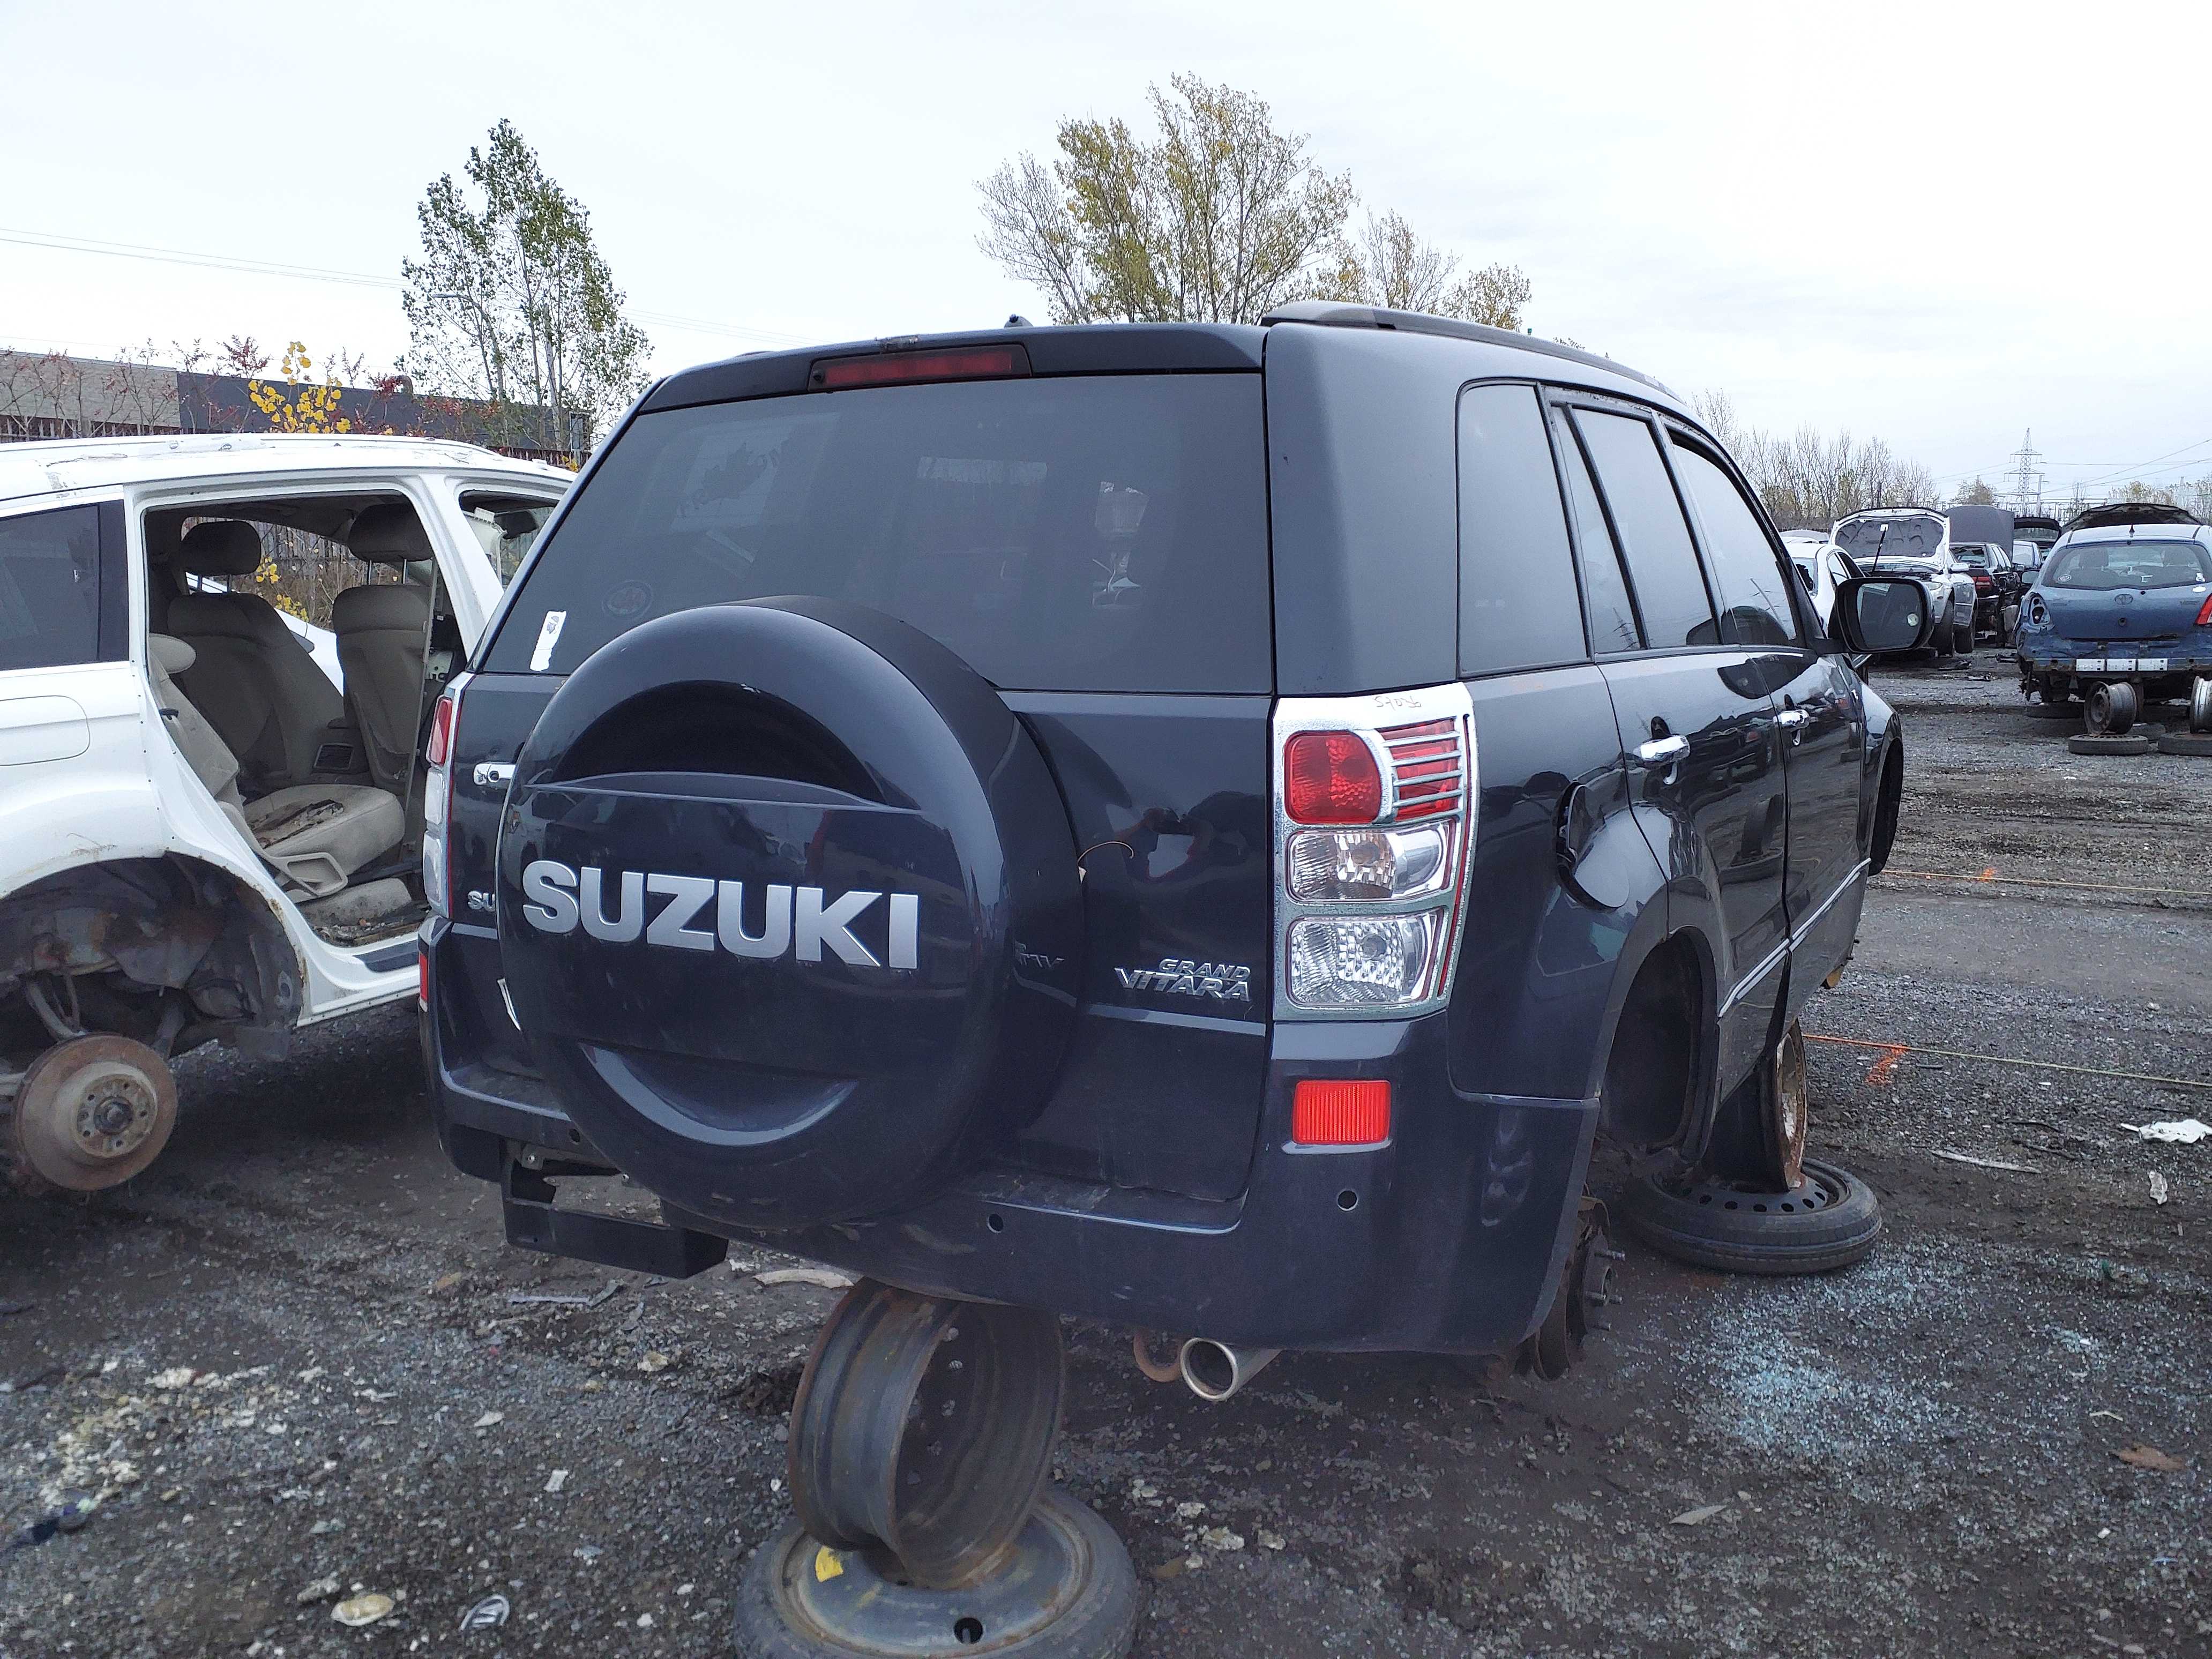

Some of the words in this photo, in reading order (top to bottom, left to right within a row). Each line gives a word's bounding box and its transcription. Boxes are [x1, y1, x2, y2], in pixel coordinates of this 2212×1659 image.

[522, 861, 919, 970] SUZUKI
[1114, 968, 1250, 1002] VITARA
[1159, 959, 1251, 982] GRAND
